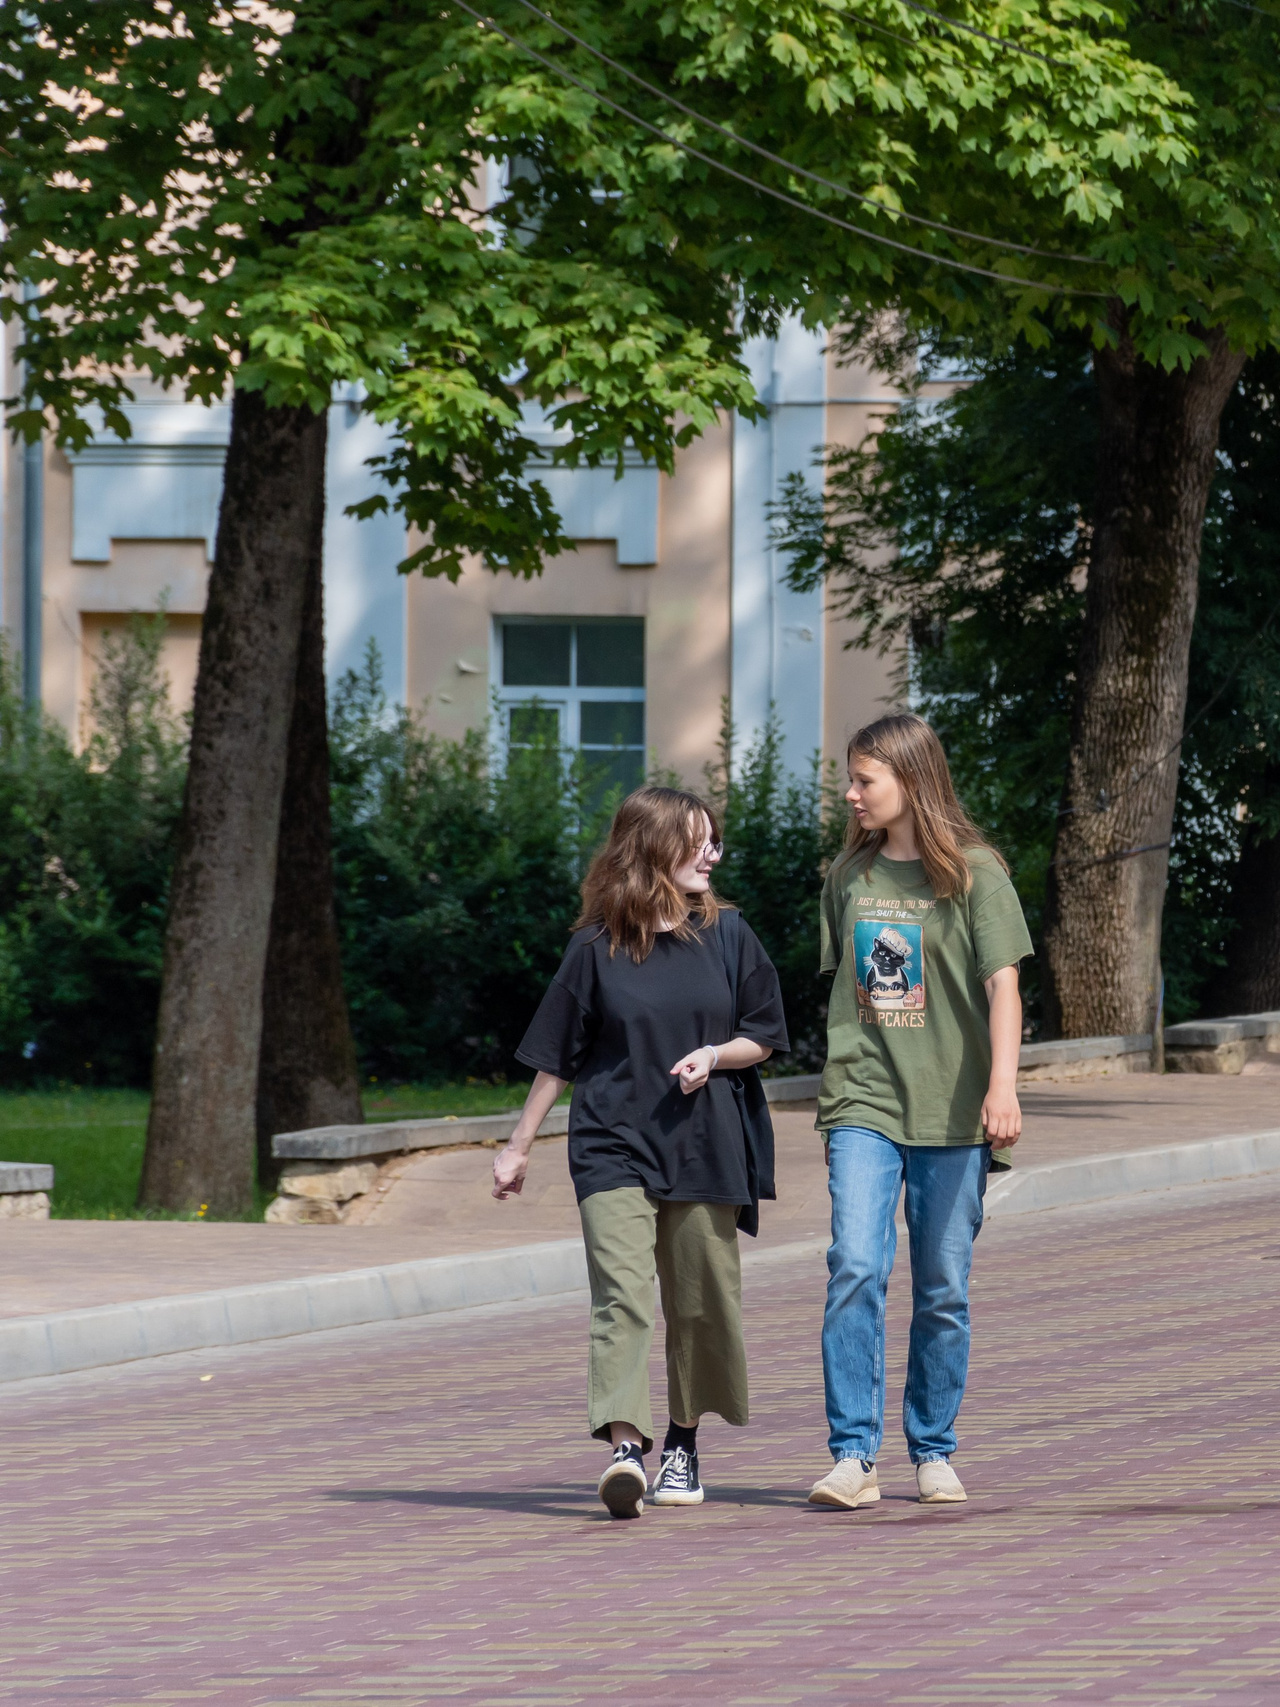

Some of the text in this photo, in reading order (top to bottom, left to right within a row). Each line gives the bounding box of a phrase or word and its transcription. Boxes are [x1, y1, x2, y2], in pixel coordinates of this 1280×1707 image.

[857, 897, 874, 906] JUST
[876, 899, 900, 909] BAKED
[903, 900, 916, 909] YOU
[918, 899, 937, 909] SOME
